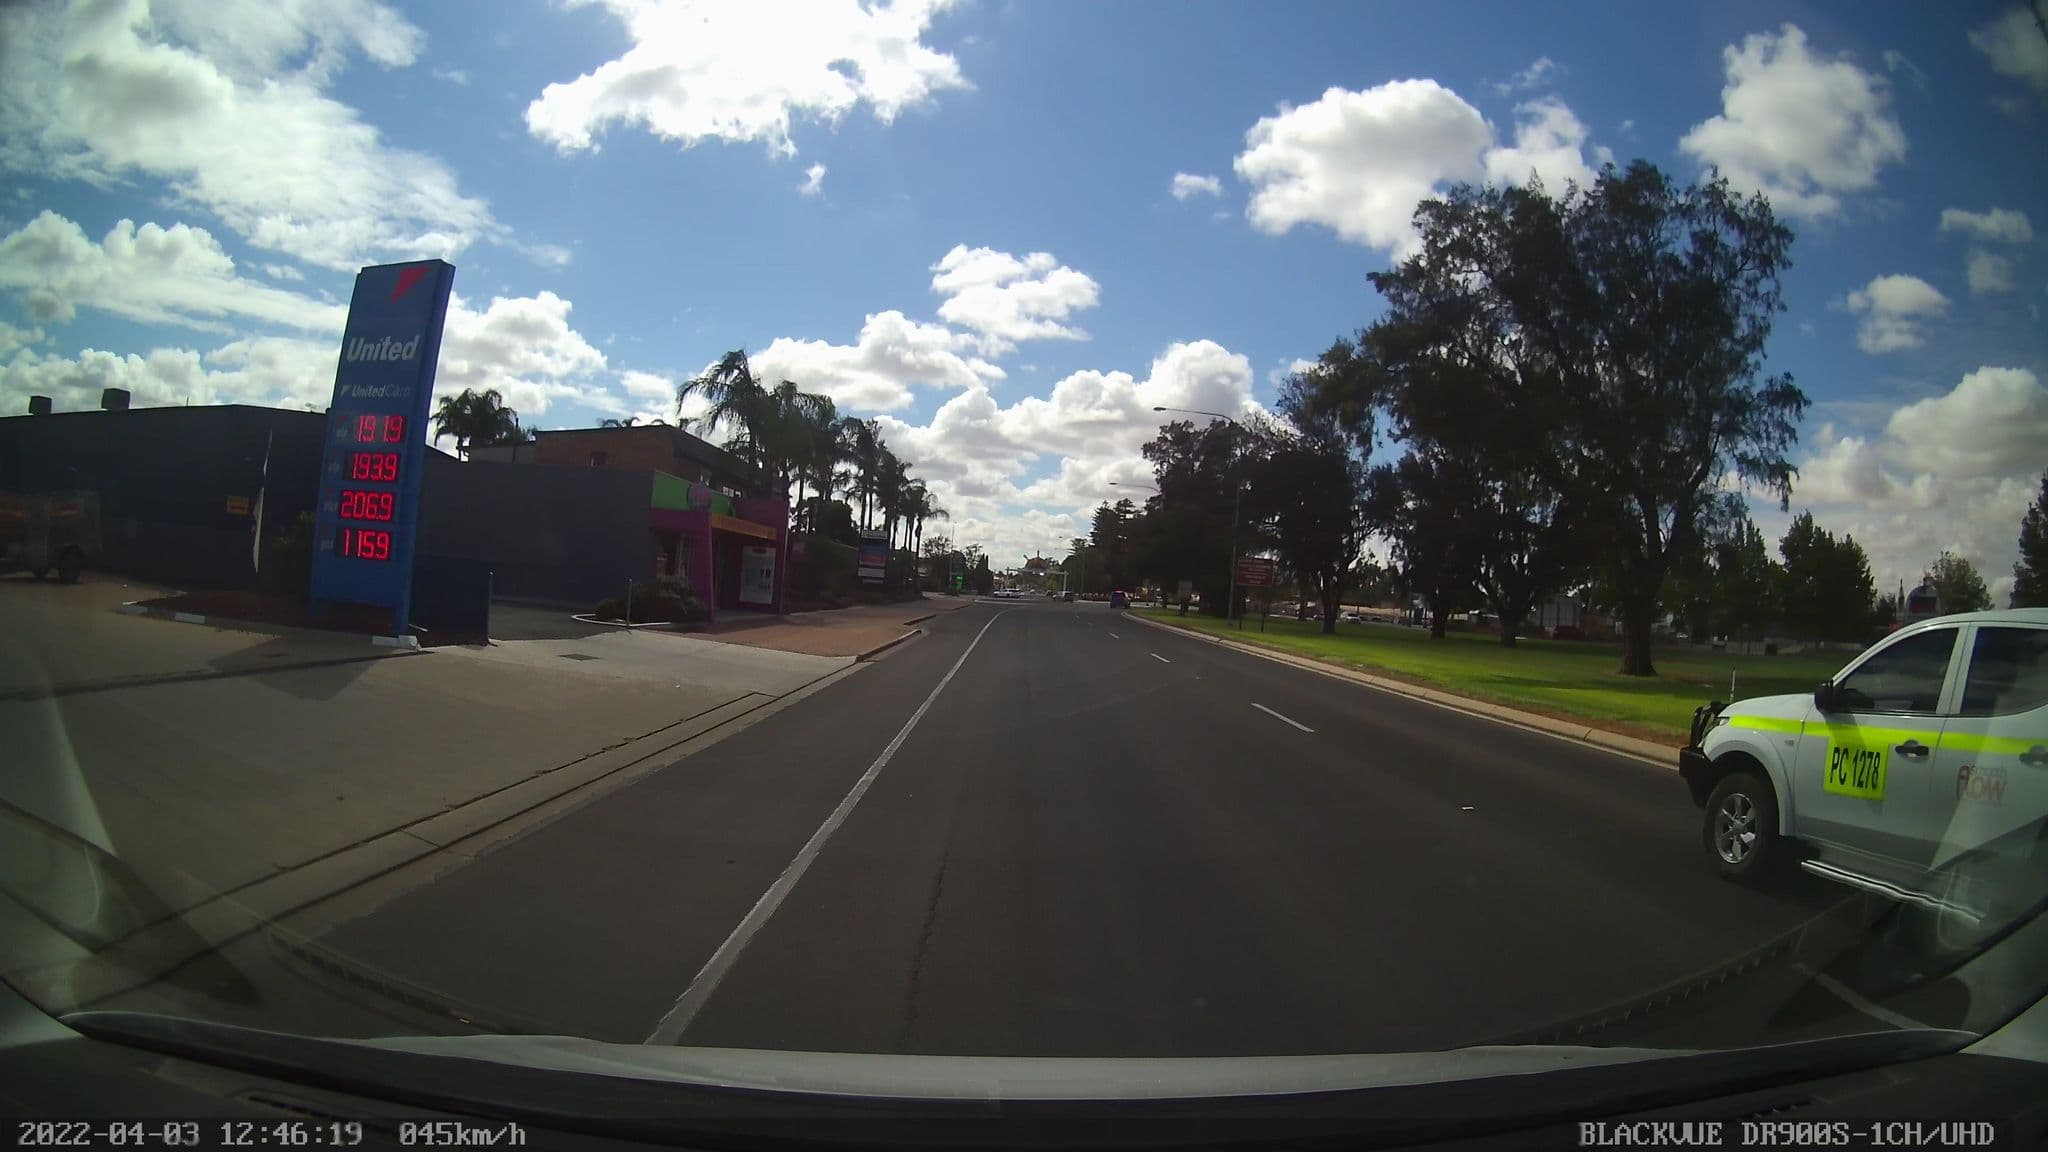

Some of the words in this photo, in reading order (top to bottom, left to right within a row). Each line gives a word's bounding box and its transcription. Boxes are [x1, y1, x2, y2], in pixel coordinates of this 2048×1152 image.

[346, 335, 420, 362] United
[1830, 746, 1849, 786] PC
[1852, 748, 1881, 790] 1278
